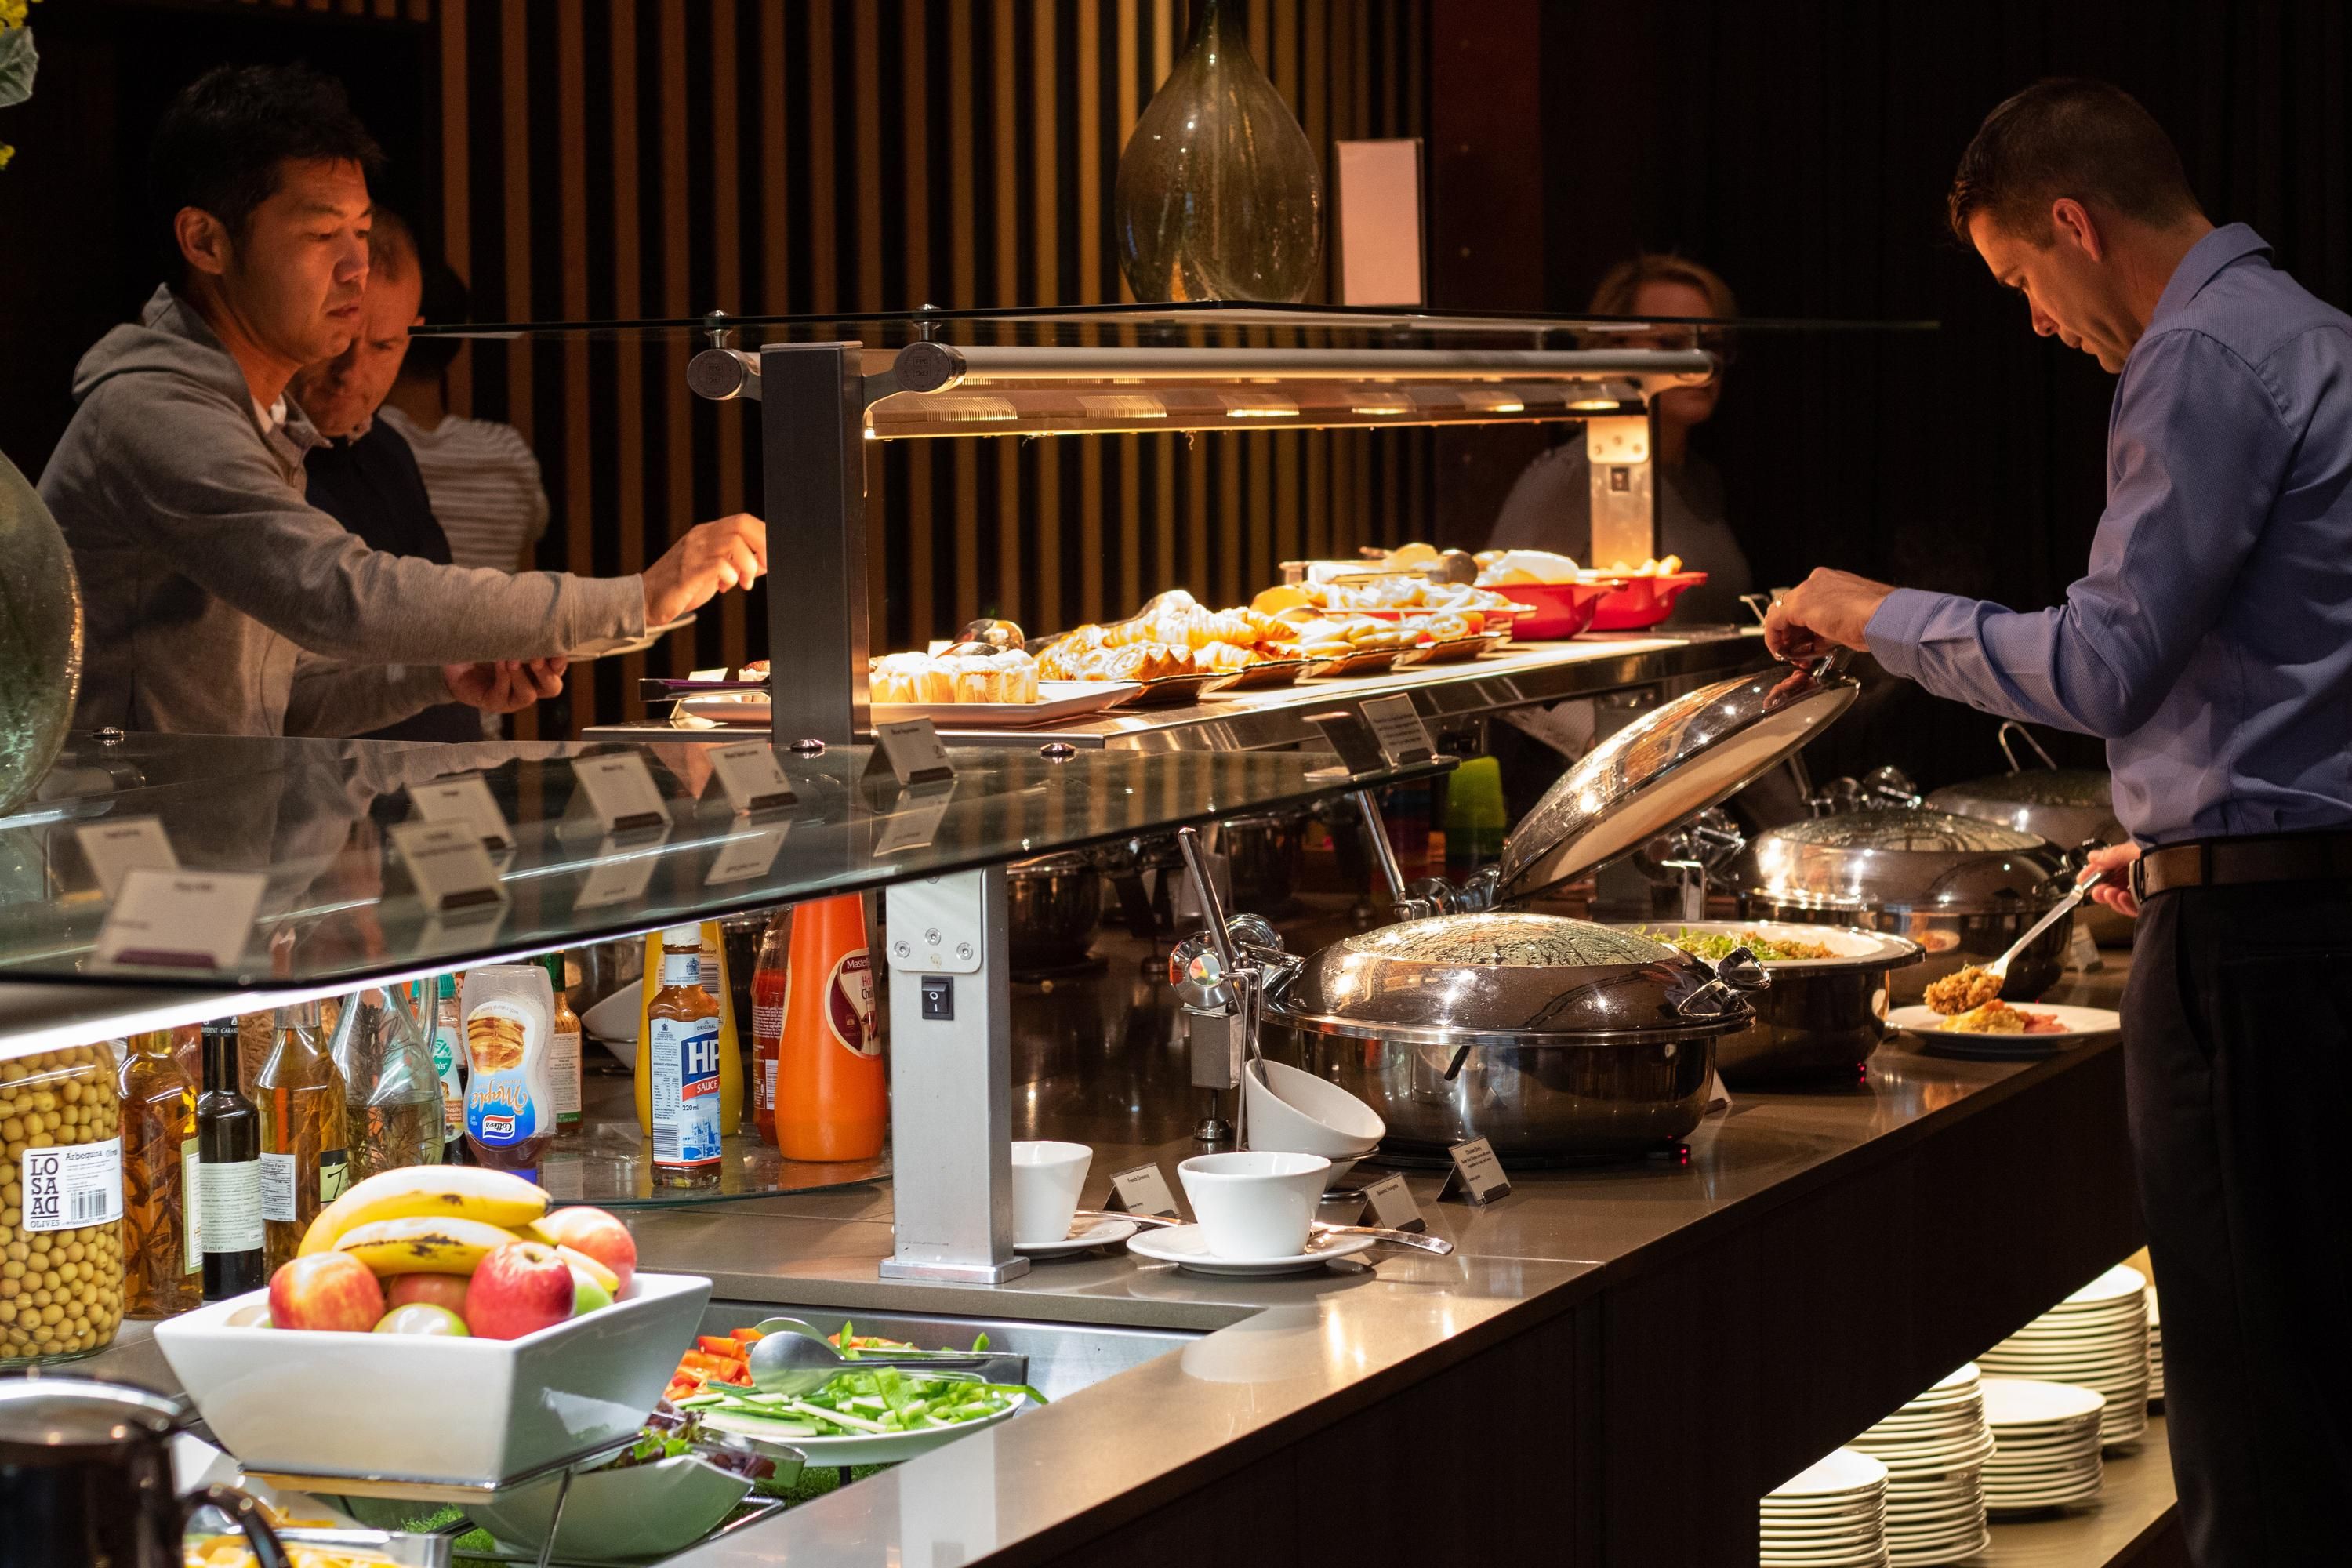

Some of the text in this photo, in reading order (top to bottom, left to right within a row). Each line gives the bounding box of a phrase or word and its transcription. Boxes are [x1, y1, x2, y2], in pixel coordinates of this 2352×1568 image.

[688, 1039, 720, 1075] HP
[697, 1080, 719, 1094] SAUCE
[470, 1079, 528, 1116] Maple
[485, 1122, 513, 1133] Cottee's
[65, 1151, 103, 1160] Arbequina
[30, 1157, 59, 1177] LO
[31, 1177, 60, 1196] SA
[30, 1219, 60, 1229] OLIVES
